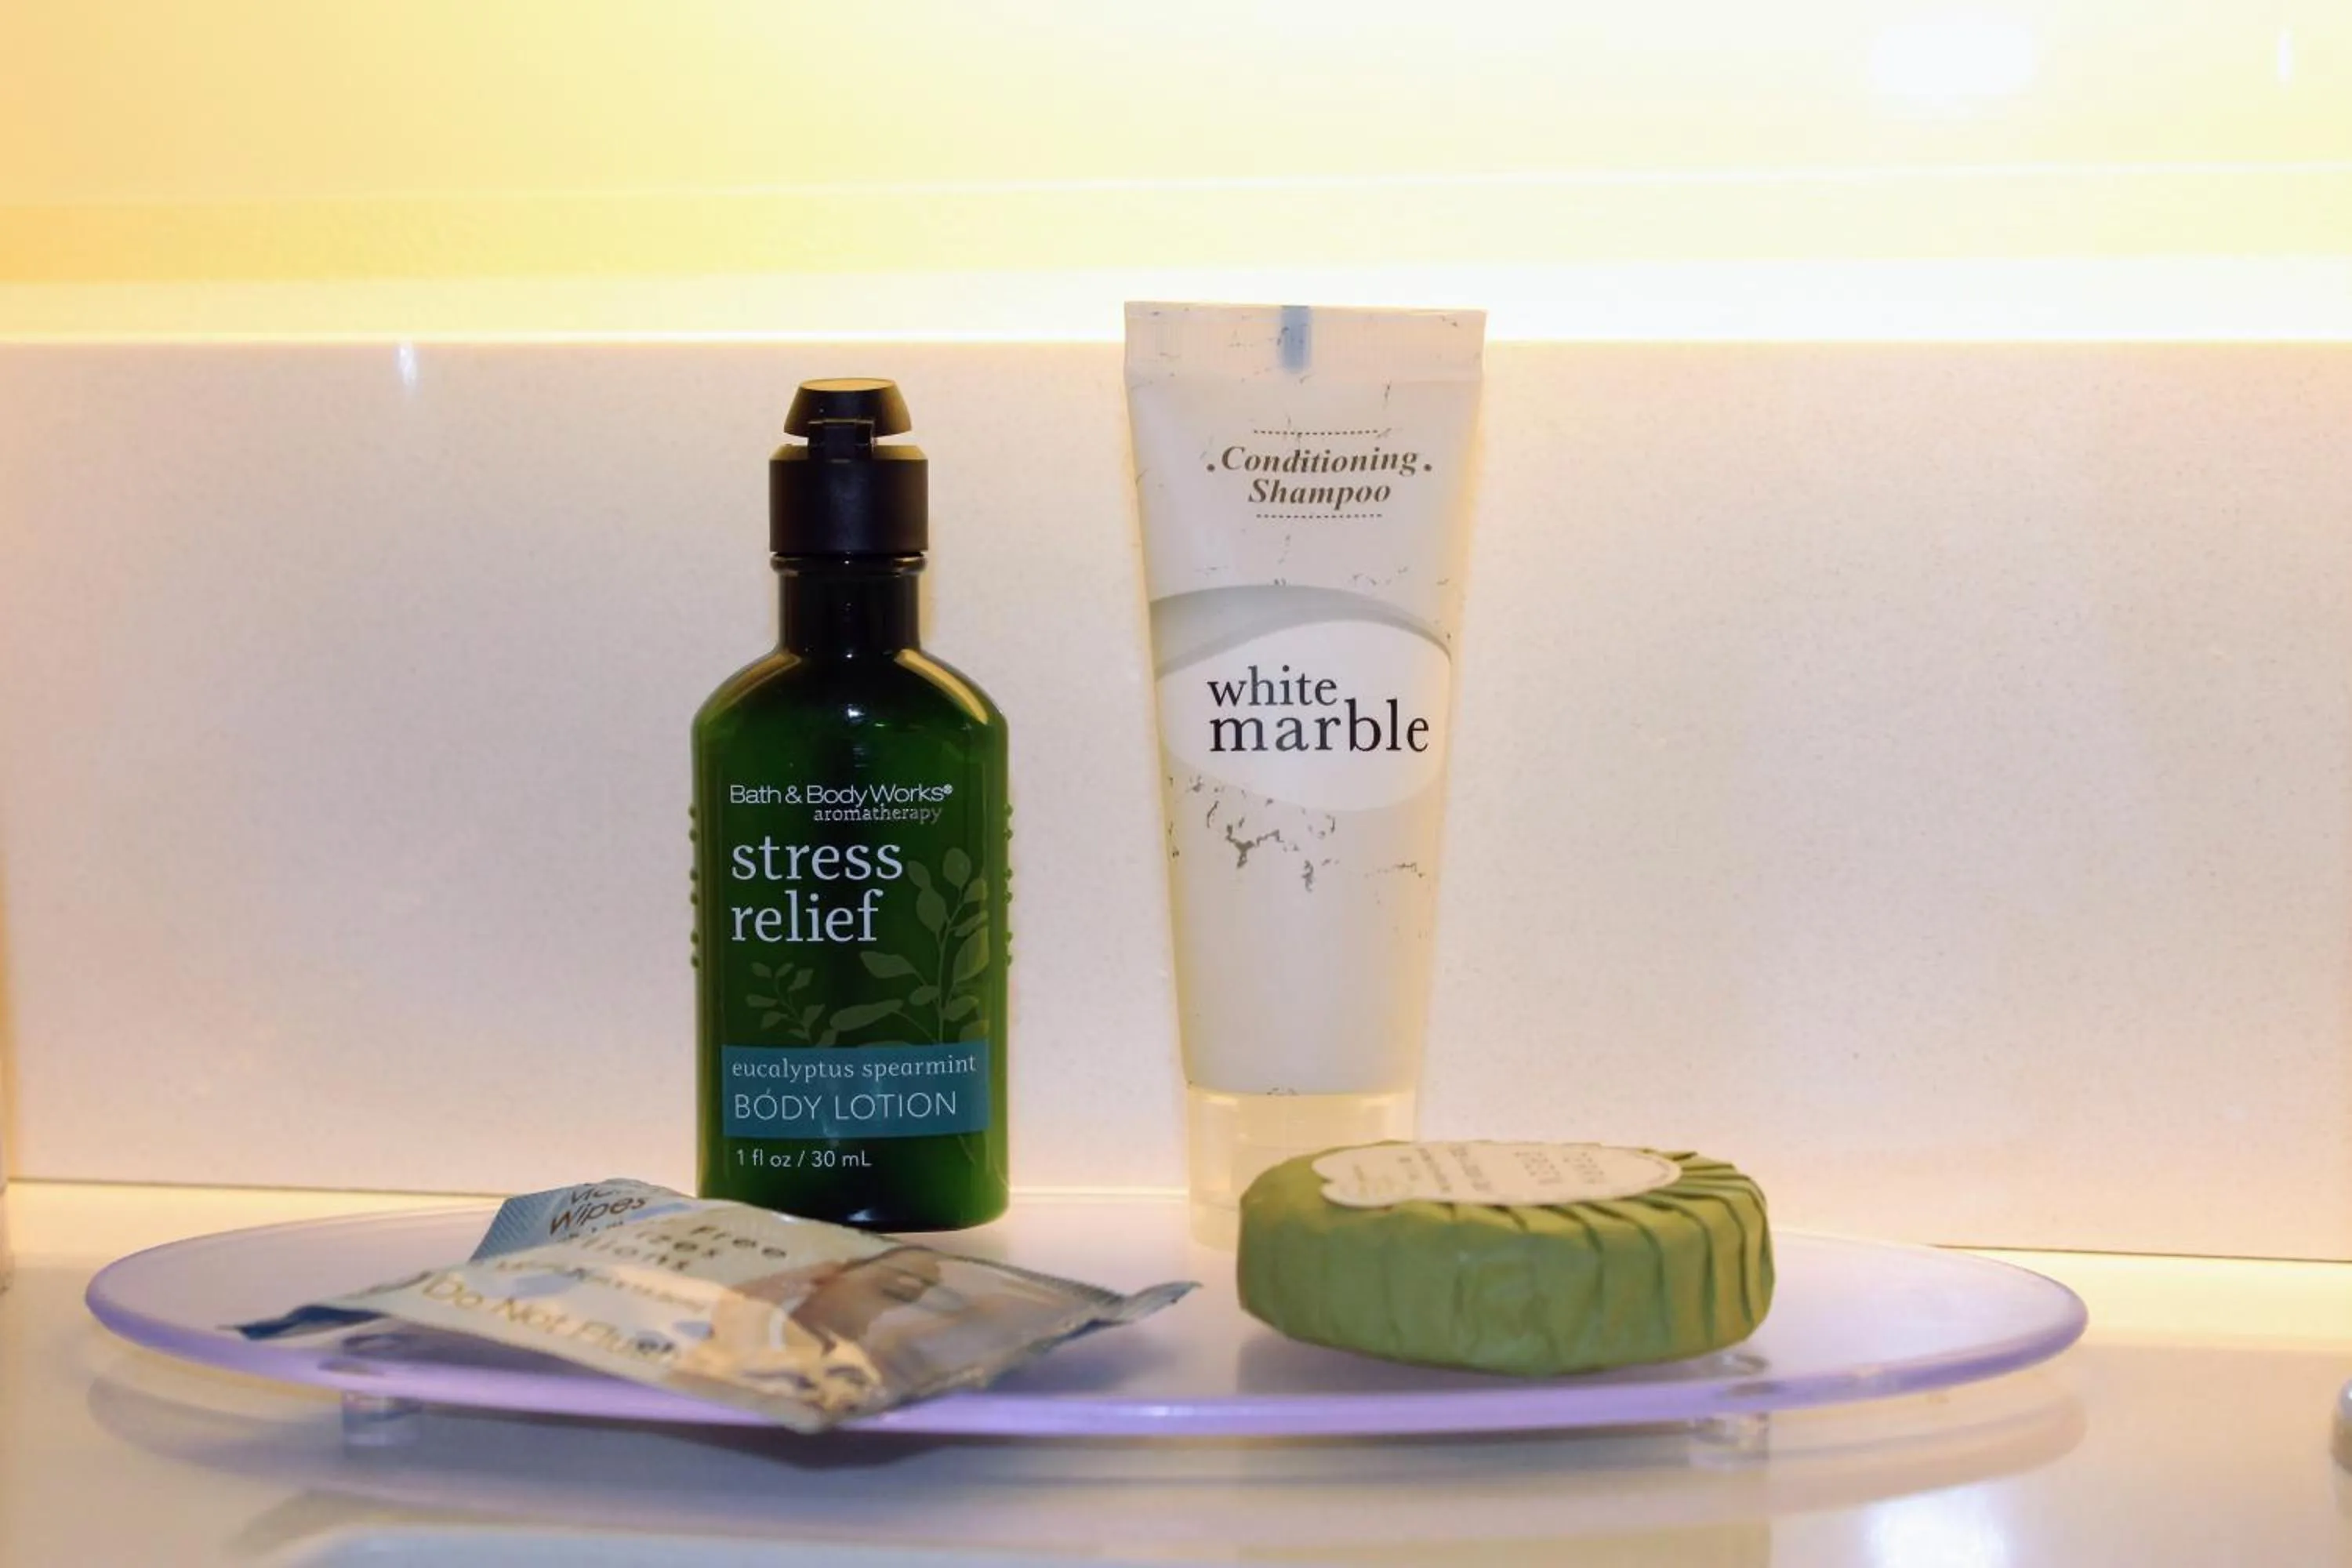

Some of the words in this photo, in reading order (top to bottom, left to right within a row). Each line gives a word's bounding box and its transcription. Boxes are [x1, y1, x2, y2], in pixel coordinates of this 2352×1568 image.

[1221, 446, 1418, 477] Conditioning
[1248, 478, 1392, 510] Shampoo
[1207, 664, 1338, 707] white
[1209, 699, 1430, 753] marble
[730, 785, 782, 804] Bath
[785, 785, 803, 804] &
[807, 785, 868, 808] Body
[813, 803, 942, 824] aromatherapy
[731, 836, 903, 880] stress
[731, 888, 884, 942] relief
[731, 1058, 855, 1083] eucalyptus
[862, 1054, 977, 1083] spearmint
[835, 1091, 956, 1120] LOTION
[736, 1149, 745, 1166] 1
[752, 1149, 764, 1166] fl
[769, 1153, 792, 1167] oz
[811, 1150, 836, 1167] 30
[841, 1149, 873, 1167] mL
[423, 1273, 483, 1309] Do
[491, 1297, 569, 1334] Not
